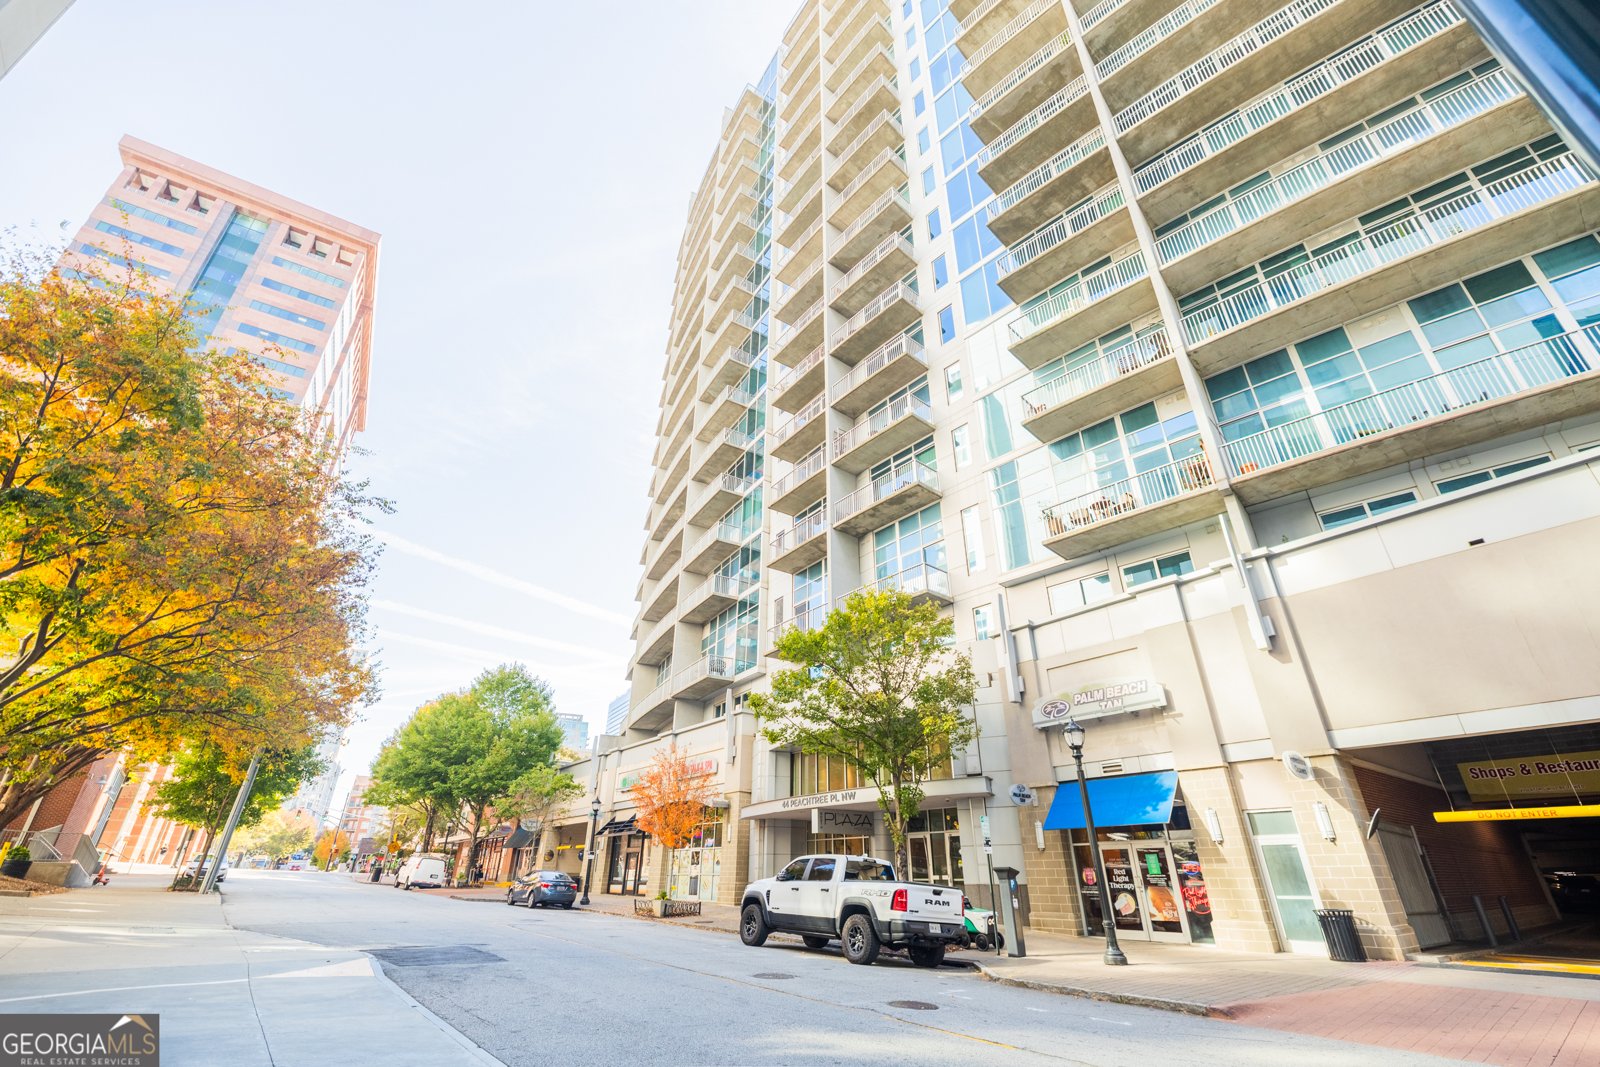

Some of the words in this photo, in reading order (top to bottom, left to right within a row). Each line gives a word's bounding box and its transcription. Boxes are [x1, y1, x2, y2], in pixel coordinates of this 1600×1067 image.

[1073, 688, 1104, 705] PALM
[1106, 681, 1147, 699] BEACH
[1100, 699, 1122, 710] TAN
[1469, 766, 1516, 780] Shops
[1519, 763, 1532, 776] &
[790, 795, 828, 808] PEACHTREE
[830, 794, 839, 803] PL
[842, 792, 856, 801] NW
[824, 812, 872, 827] PLAZA
[1113, 875, 1129, 883] Light
[1109, 882, 1135, 890] Therapy
[925, 899, 950, 907] RAM
